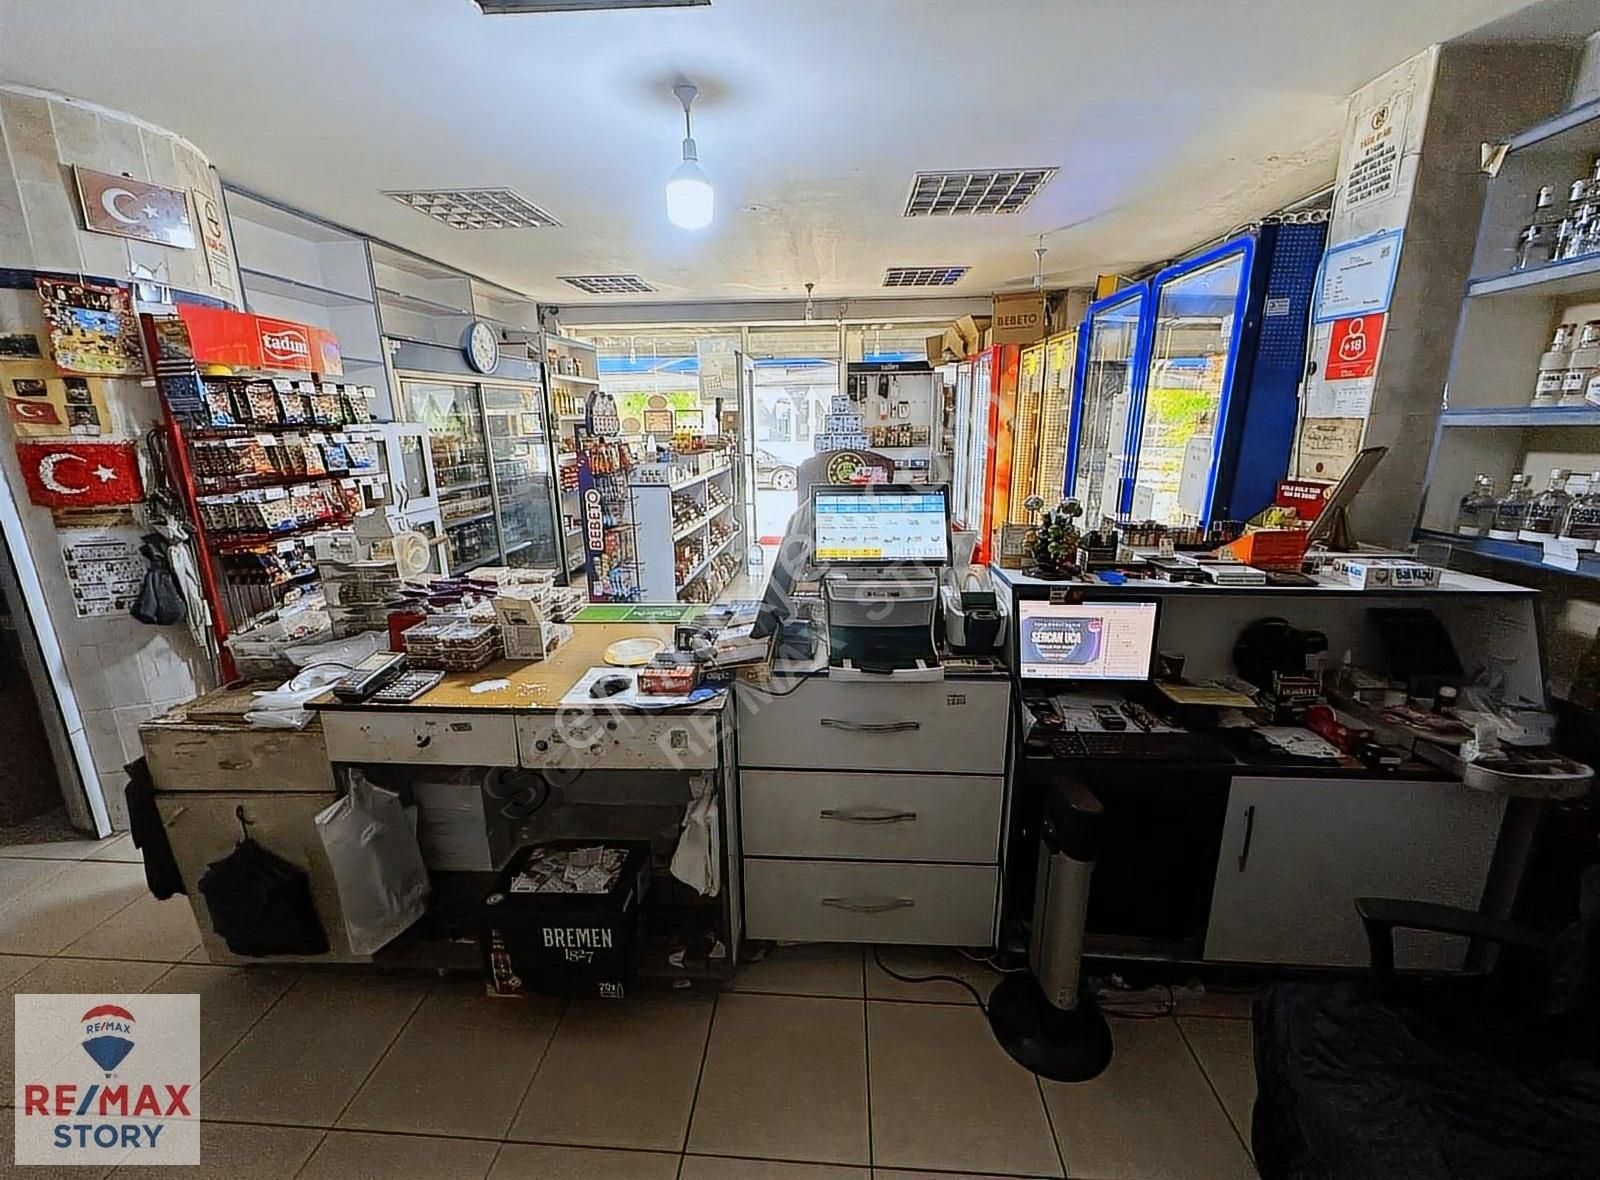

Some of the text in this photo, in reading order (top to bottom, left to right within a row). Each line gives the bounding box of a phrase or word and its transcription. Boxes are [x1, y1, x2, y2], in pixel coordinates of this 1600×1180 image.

[997, 314, 1037, 326] BEBETO
[585, 489, 603, 550] BEBETO
[543, 928, 612, 948] BREMEN
